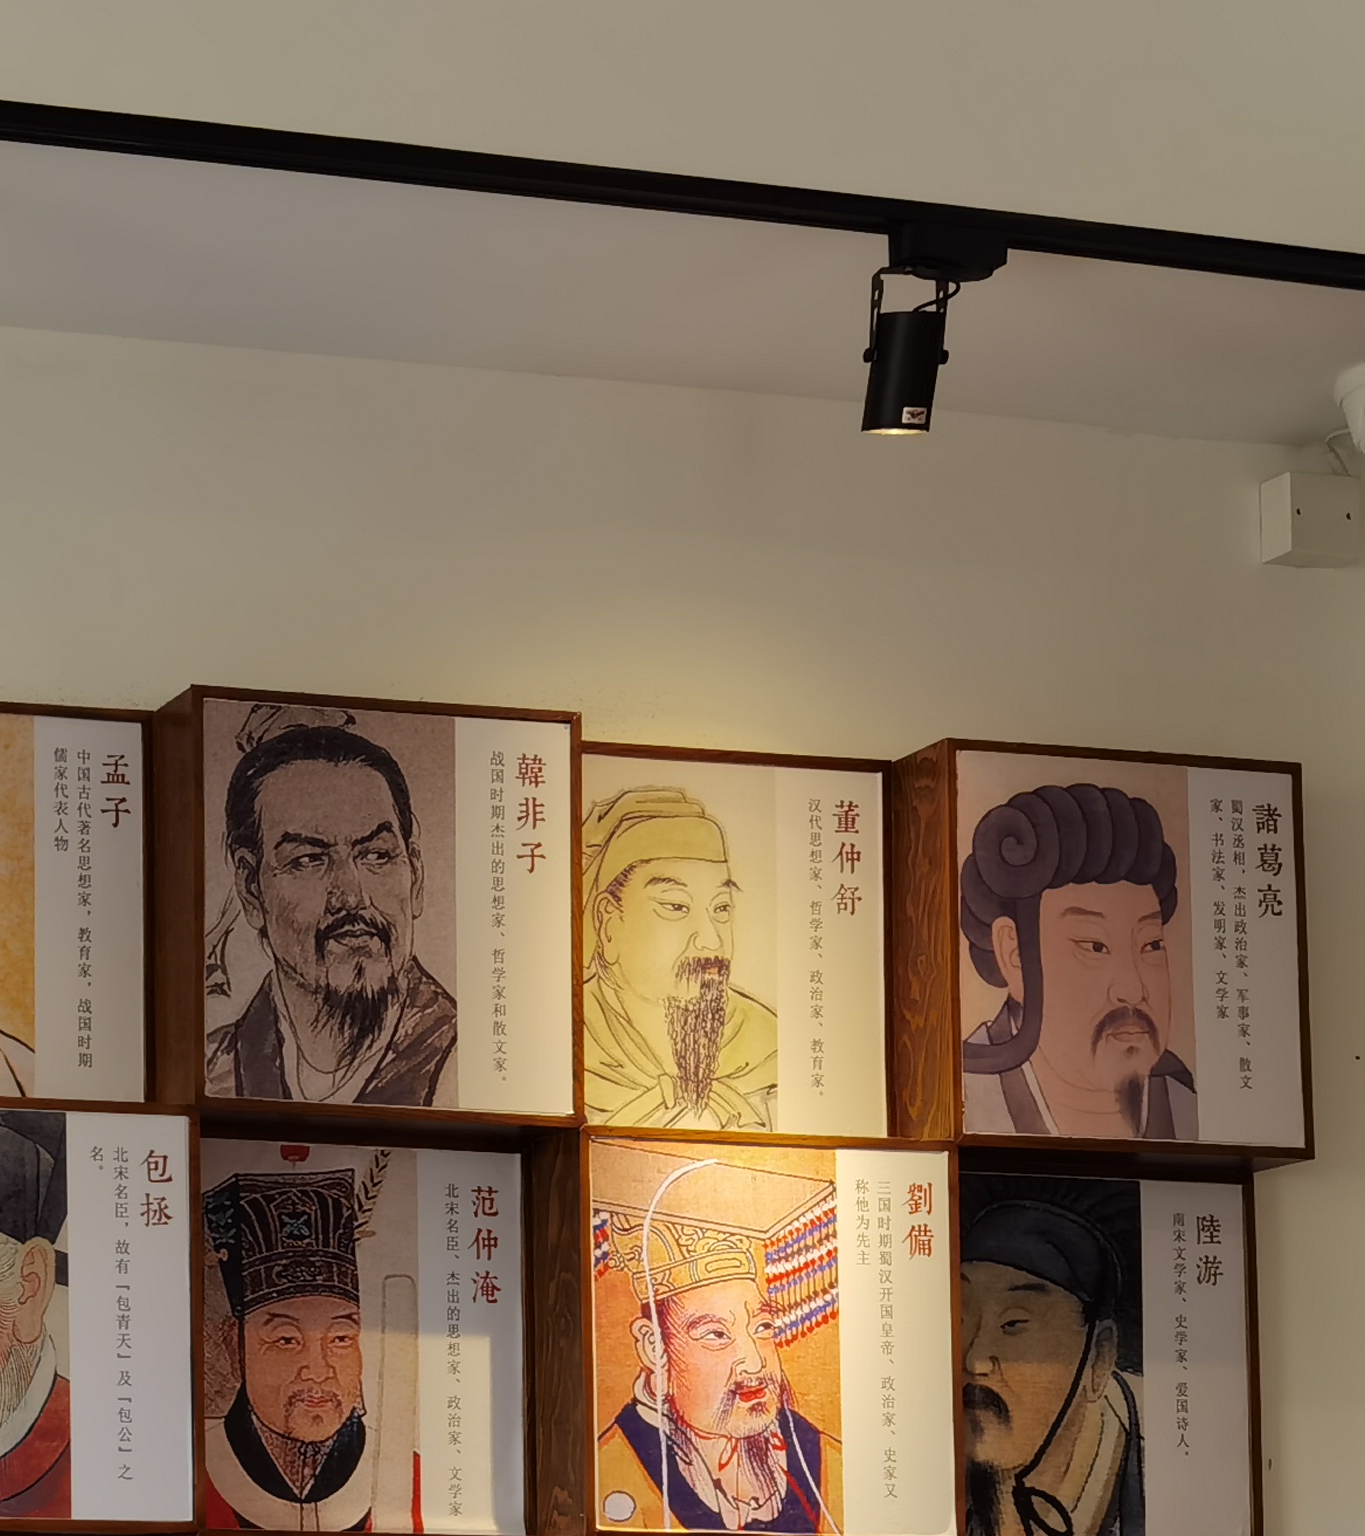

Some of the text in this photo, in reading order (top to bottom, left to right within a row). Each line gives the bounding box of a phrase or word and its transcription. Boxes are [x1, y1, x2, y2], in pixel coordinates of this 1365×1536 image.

[53, 747, 69, 852] 儒家代表人物
[100, 754, 131, 828] 孟子
[515, 753, 547, 874] 韓非子
[831, 800, 862, 916] 董仲舒
[1252, 803, 1283, 918] 諸葛亮
[140, 1149, 174, 1228] 包拯
[854, 1179, 871, 1266] 称他为先主
[901, 1182, 934, 1261] 劉備
[468, 1186, 502, 1304] 范仲淹
[1196, 1214, 1224, 1287] 陸游
